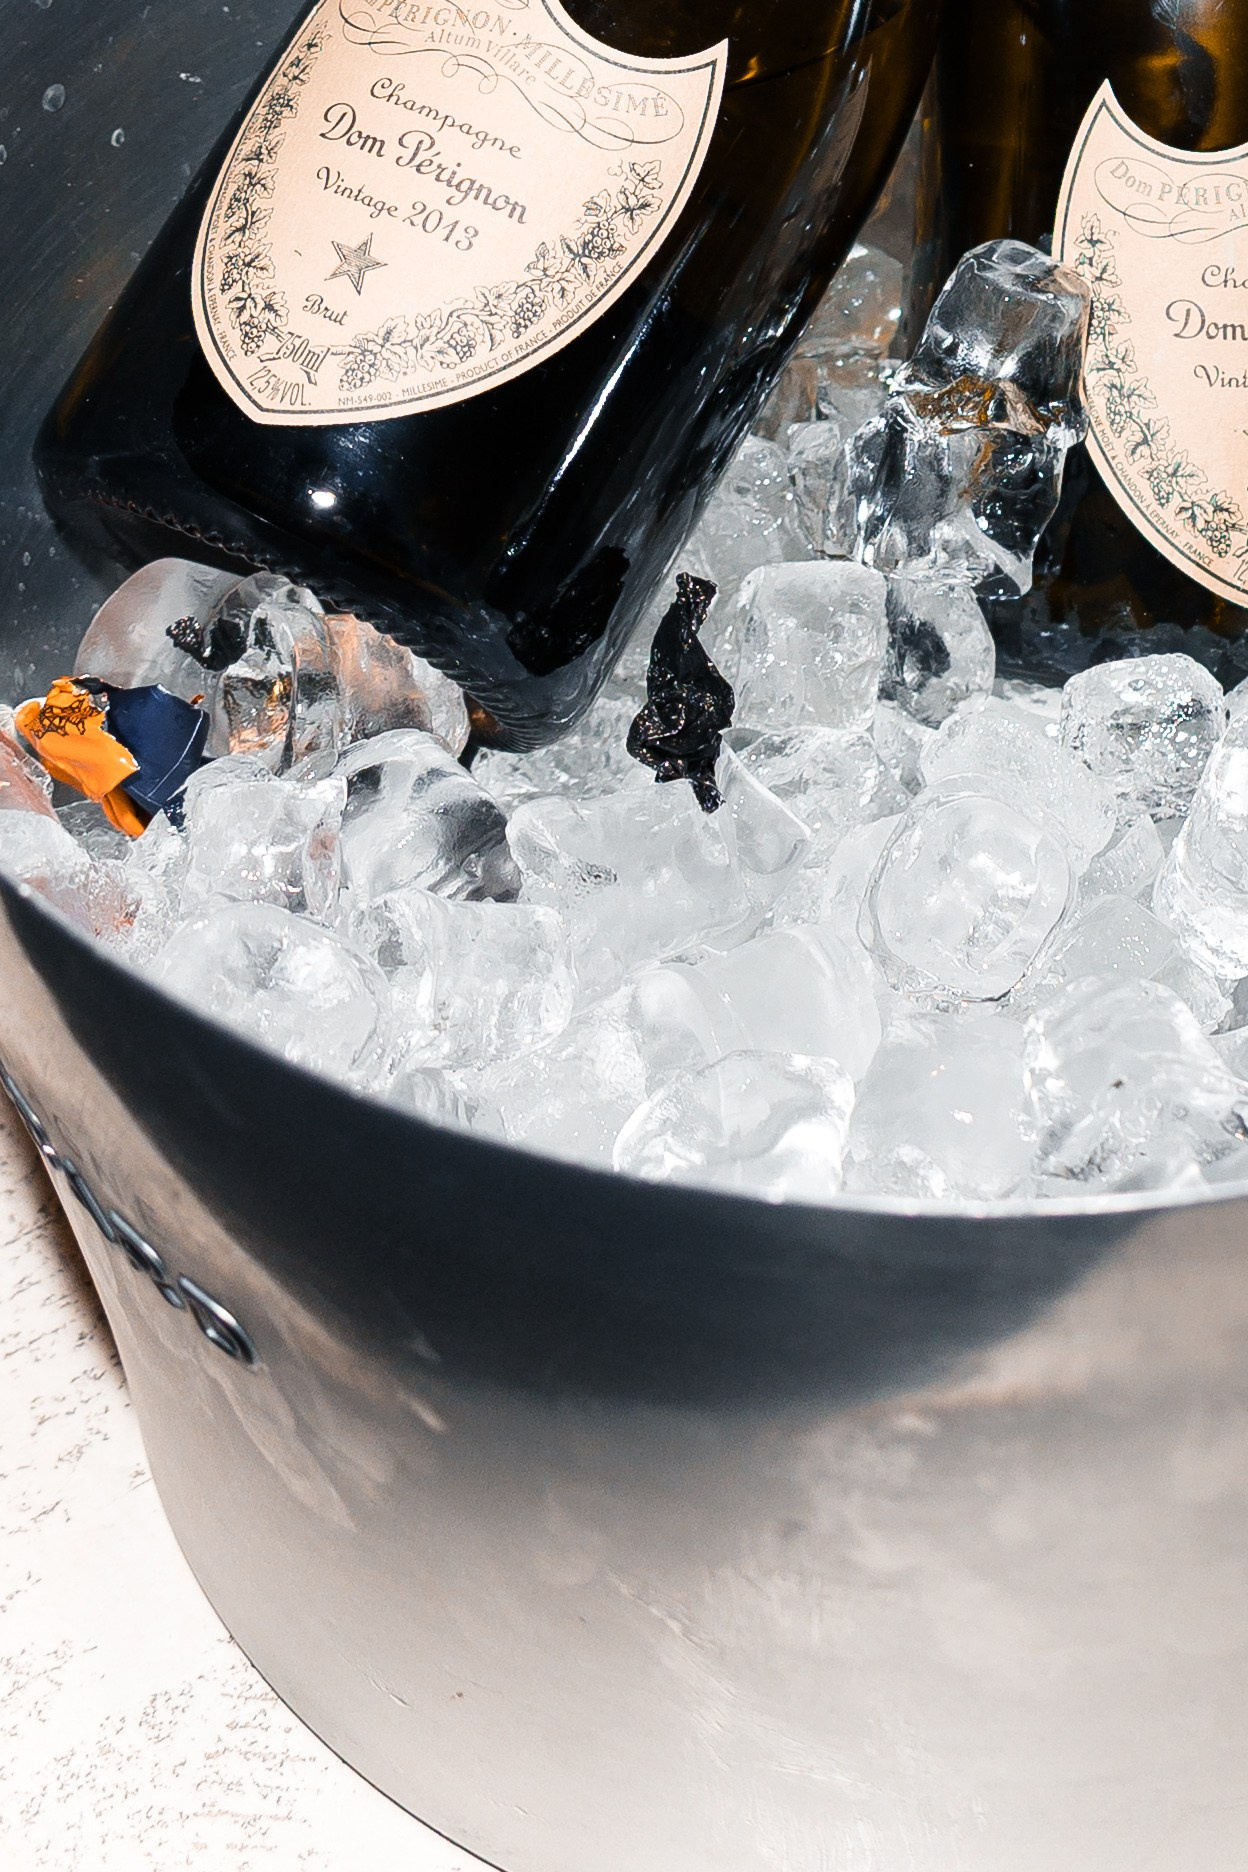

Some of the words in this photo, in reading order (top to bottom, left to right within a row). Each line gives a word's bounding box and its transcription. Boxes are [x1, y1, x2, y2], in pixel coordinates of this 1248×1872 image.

[424, 29, 481, 49] Altum
[486, 40, 536, 85] Villare
[370, 77, 522, 159] Champagne
[319, 102, 386, 157] Dom
[395, 130, 527, 225] Pérignon
[1110, 160, 1152, 197] Dom
[317, 166, 398, 218] Vintage
[402, 201, 479, 251] 2013
[302, 293, 348, 326] Brut
[338, 391, 392, 407] NM-549-002
[401, 378, 449, 398] MILLESIME
[455, 358, 500, 382] PRODUCT
[501, 350, 514, 363] OF
[514, 329, 549, 357] FRANCE
[552, 301, 587, 331] PRODUIT
[585, 290, 596, 303] DE
[595, 261, 624, 293] FRANCE
[1165, 299, 1248, 341] Dom
[217, 333, 238, 362] FRANCE
[1115, 461, 1148, 504] CHANDON
[1150, 510, 1180, 540] EPERNAY
[1183, 541, 1214, 568] FRANCE
